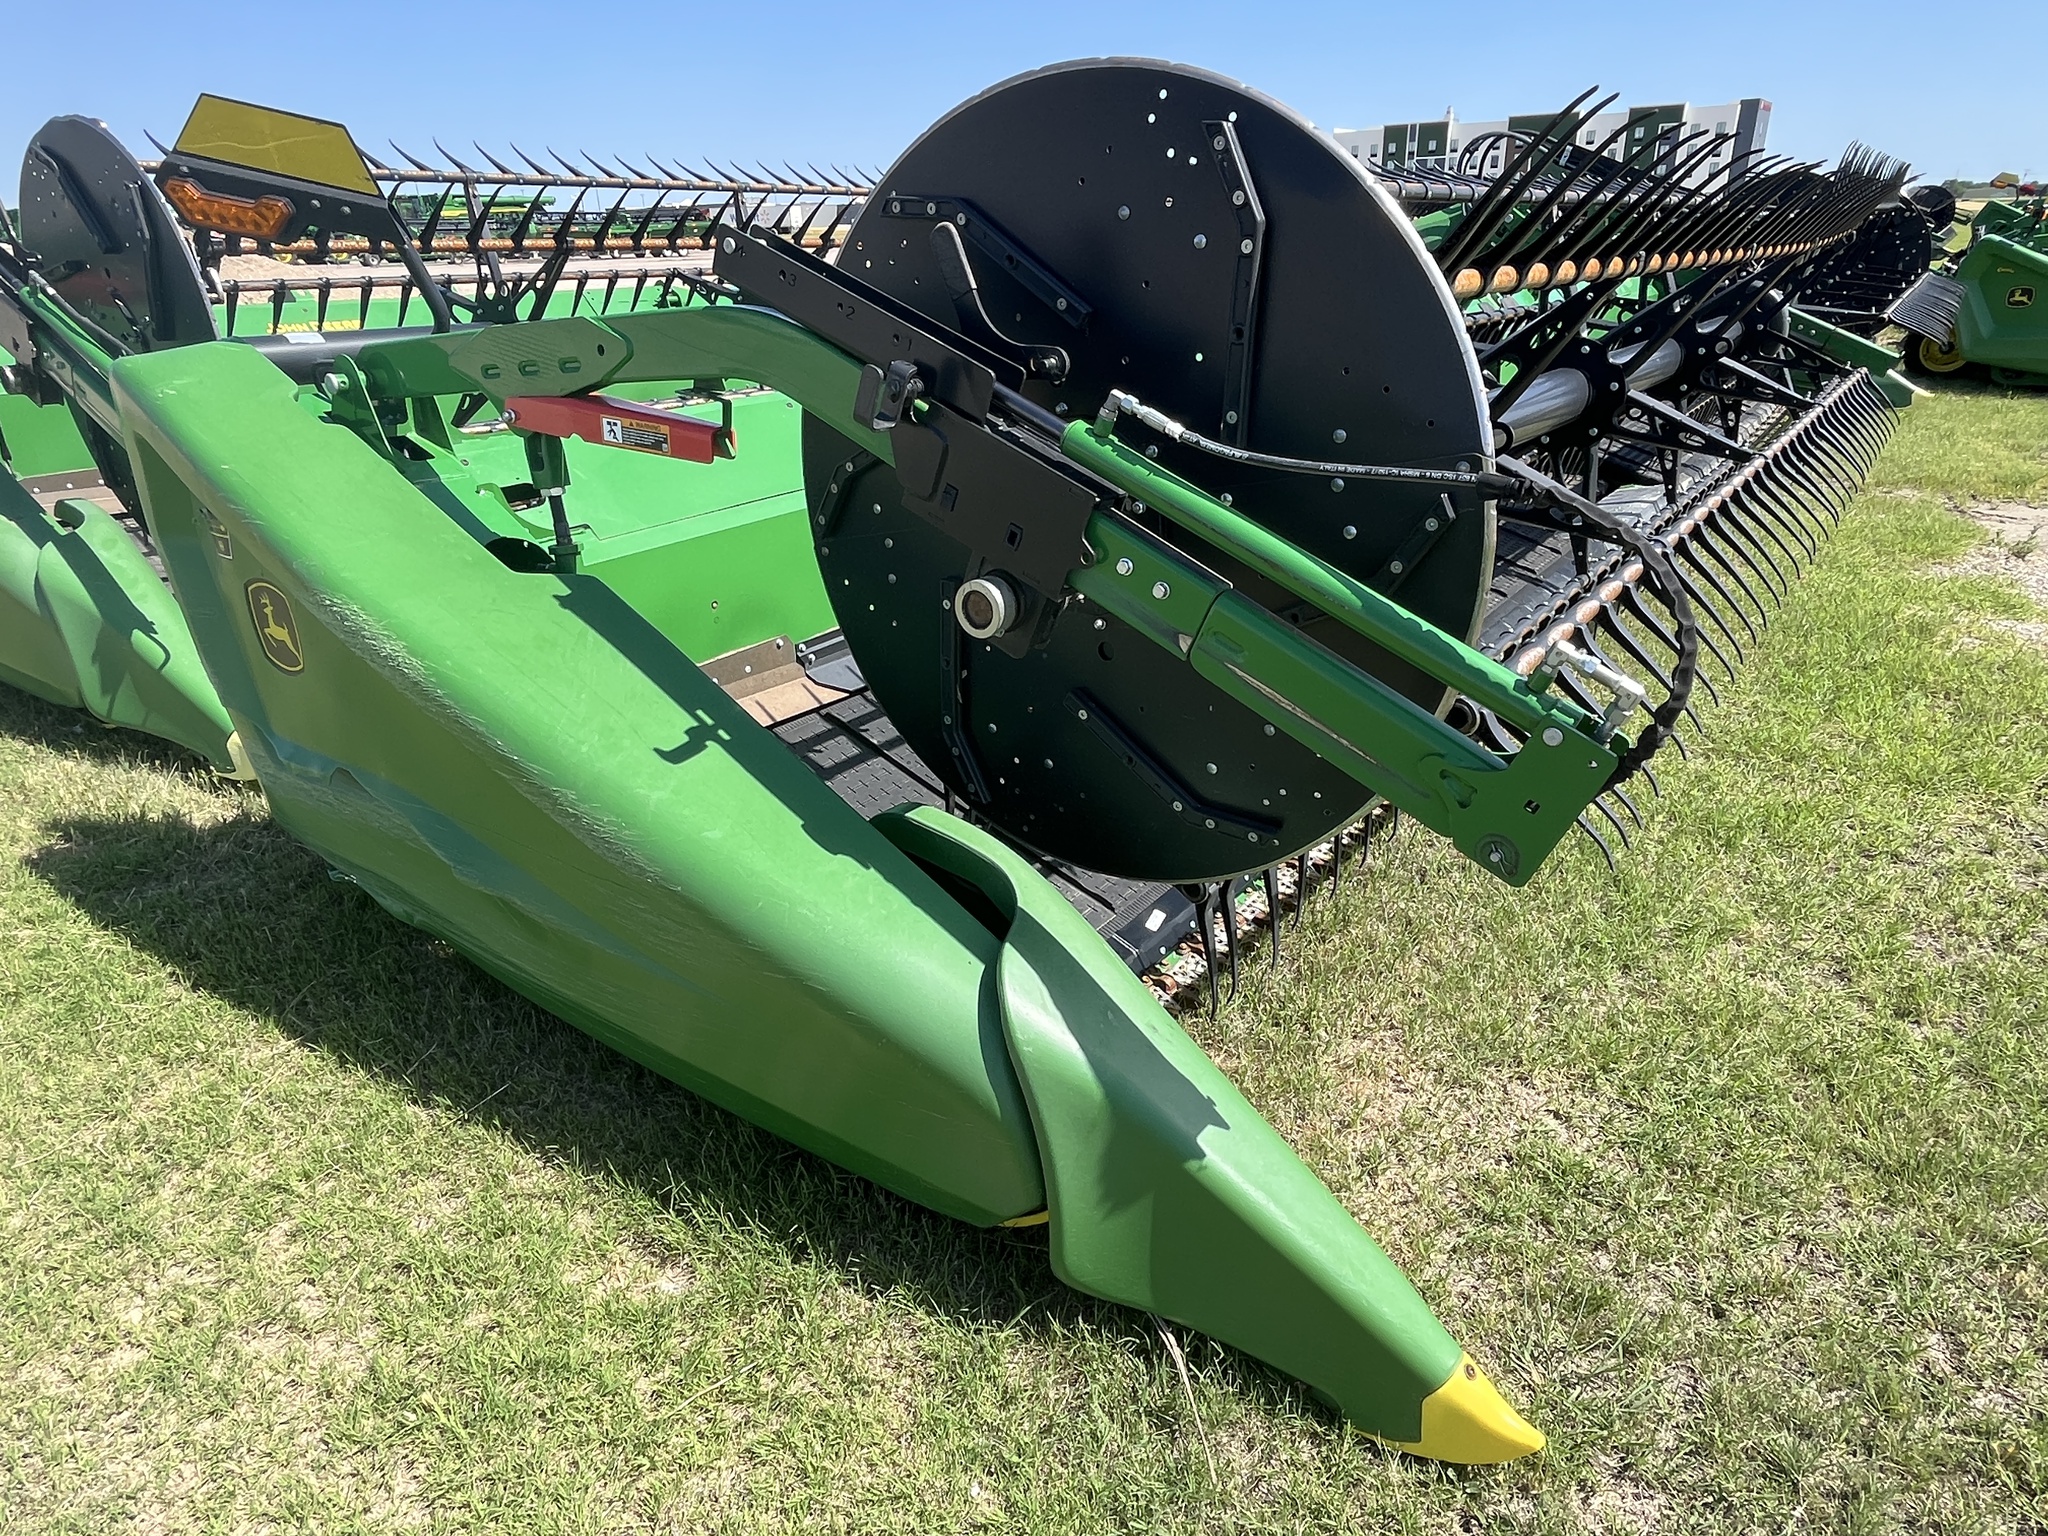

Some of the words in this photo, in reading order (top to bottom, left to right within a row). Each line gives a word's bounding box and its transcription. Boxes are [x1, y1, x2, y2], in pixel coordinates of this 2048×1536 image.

[787, 272, 797, 287] 3
[845, 305, 856, 320] 2
[266, 322, 309, 334] JOHN
[1319, 464, 1337, 472] ITALY
[1337, 465, 1346, 473] IN
[1346, 466, 1366, 474] MADE
